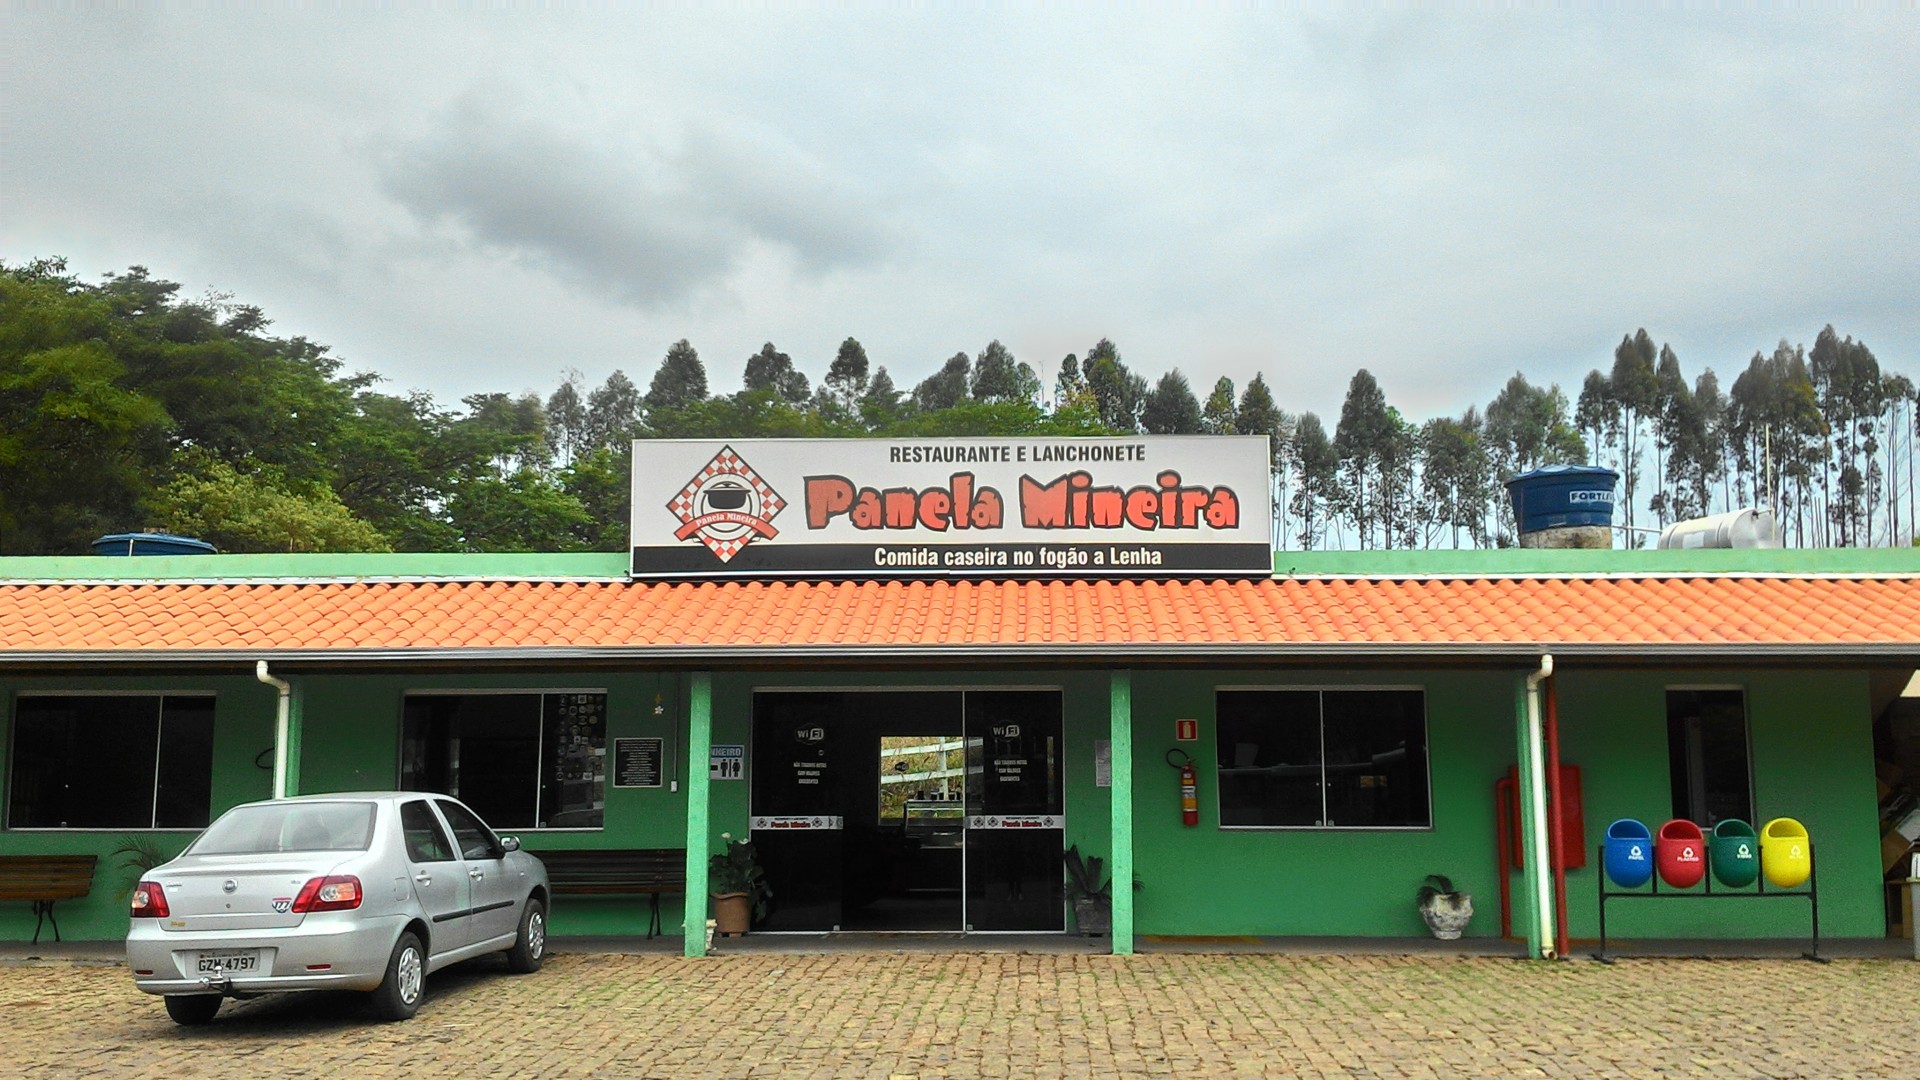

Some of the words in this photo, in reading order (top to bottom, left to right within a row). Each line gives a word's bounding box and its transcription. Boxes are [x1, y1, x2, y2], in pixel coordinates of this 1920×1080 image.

[890, 446, 1010, 462] RESTAURANTE
[1016, 446, 1026, 461] E
[1032, 444, 1146, 461] LANCHONETE
[803, 471, 1004, 531] Panela
[1019, 470, 1240, 531] Mineira
[874, 547, 938, 566] Comida
[944, 547, 1007, 566] caseira
[1013, 551, 1034, 566] no
[1039, 547, 1088, 568] fogão
[1093, 551, 1104, 565] a
[1110, 547, 1162, 565] Lenha
[711, 747, 742, 756] NHEIRO
